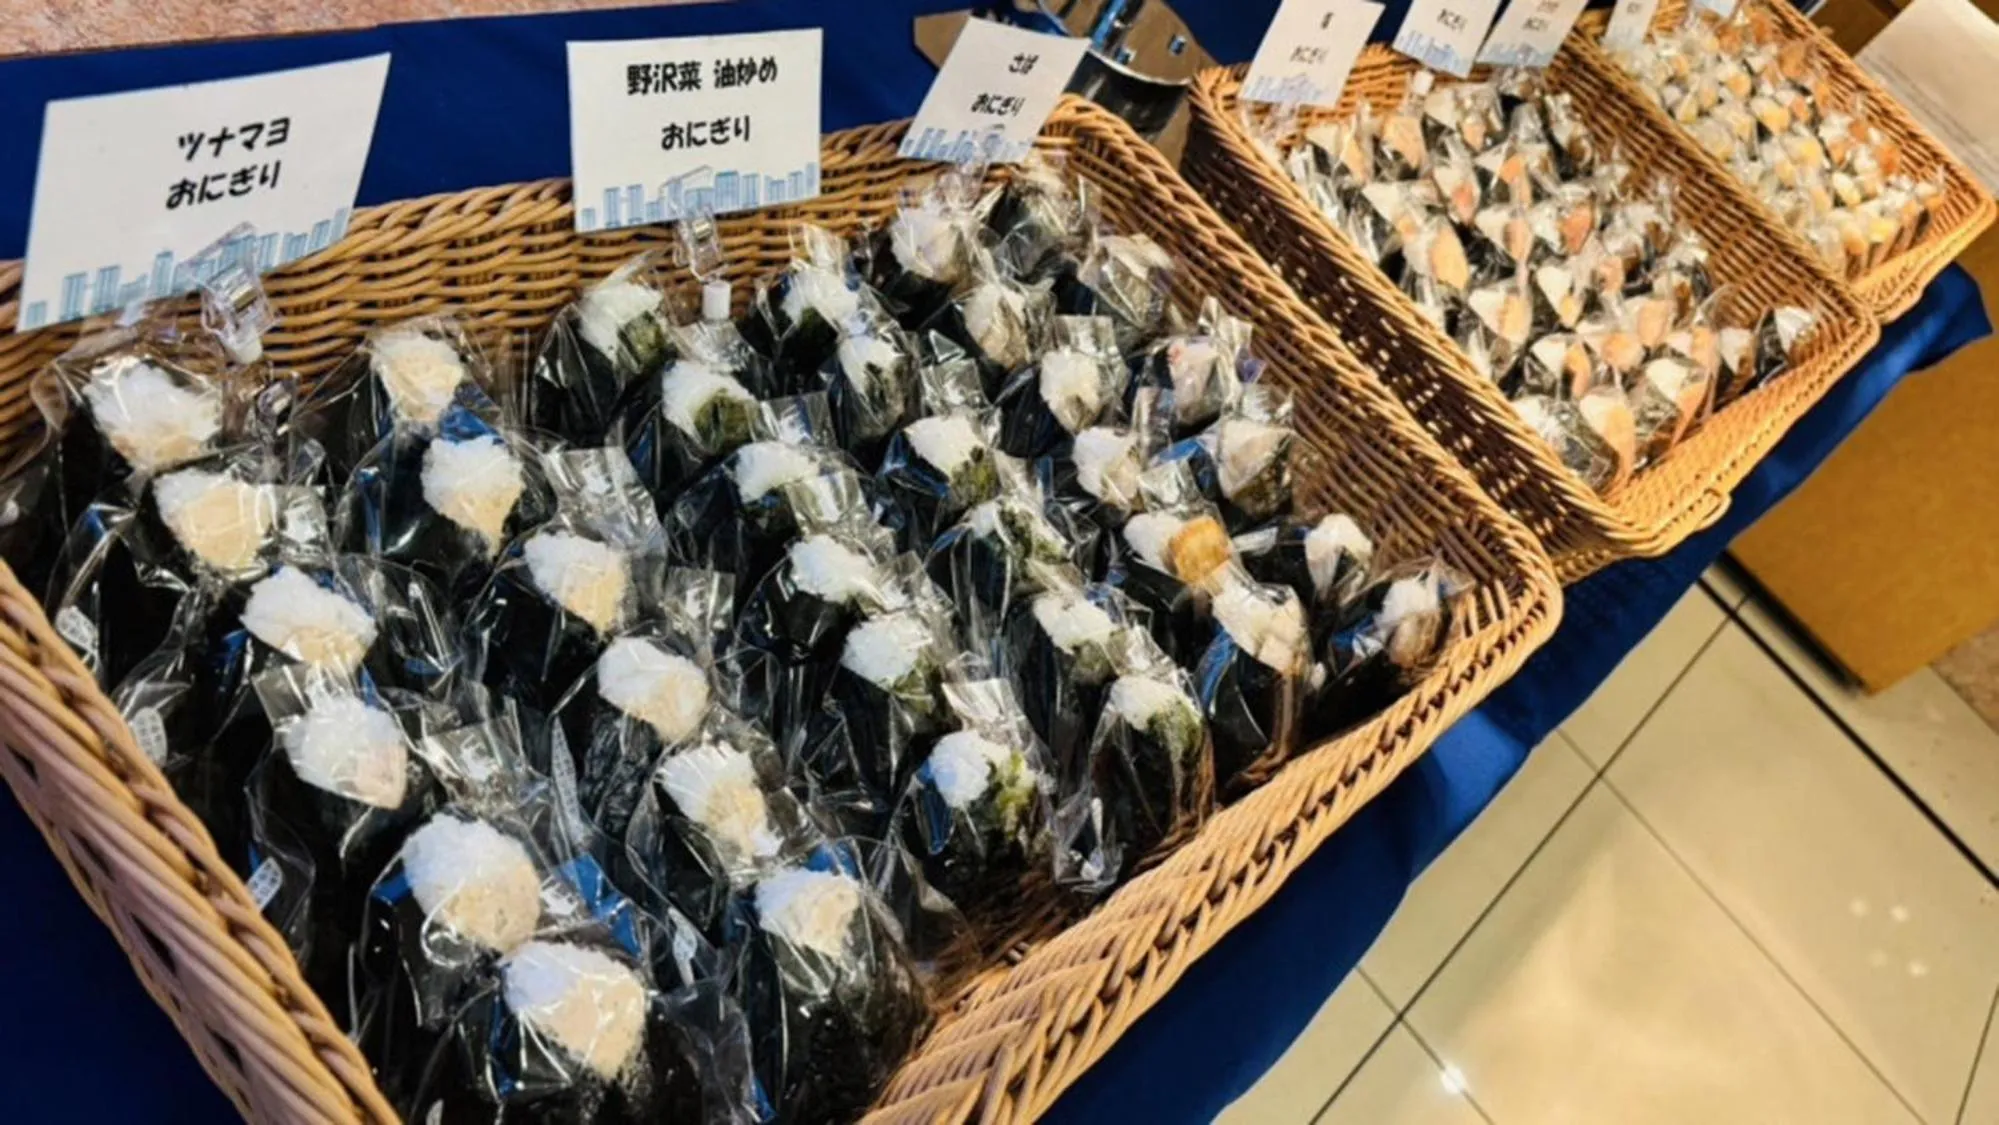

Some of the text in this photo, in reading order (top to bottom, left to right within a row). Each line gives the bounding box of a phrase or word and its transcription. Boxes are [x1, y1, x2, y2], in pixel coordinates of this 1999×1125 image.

[626, 54, 778, 96] 野沢菜 油炒め
[970, 92, 1025, 117] おにぎり
[178, 116, 291, 162] ツナマヨ
[660, 114, 751, 151] おにぎり
[165, 159, 282, 210] おにぎり
